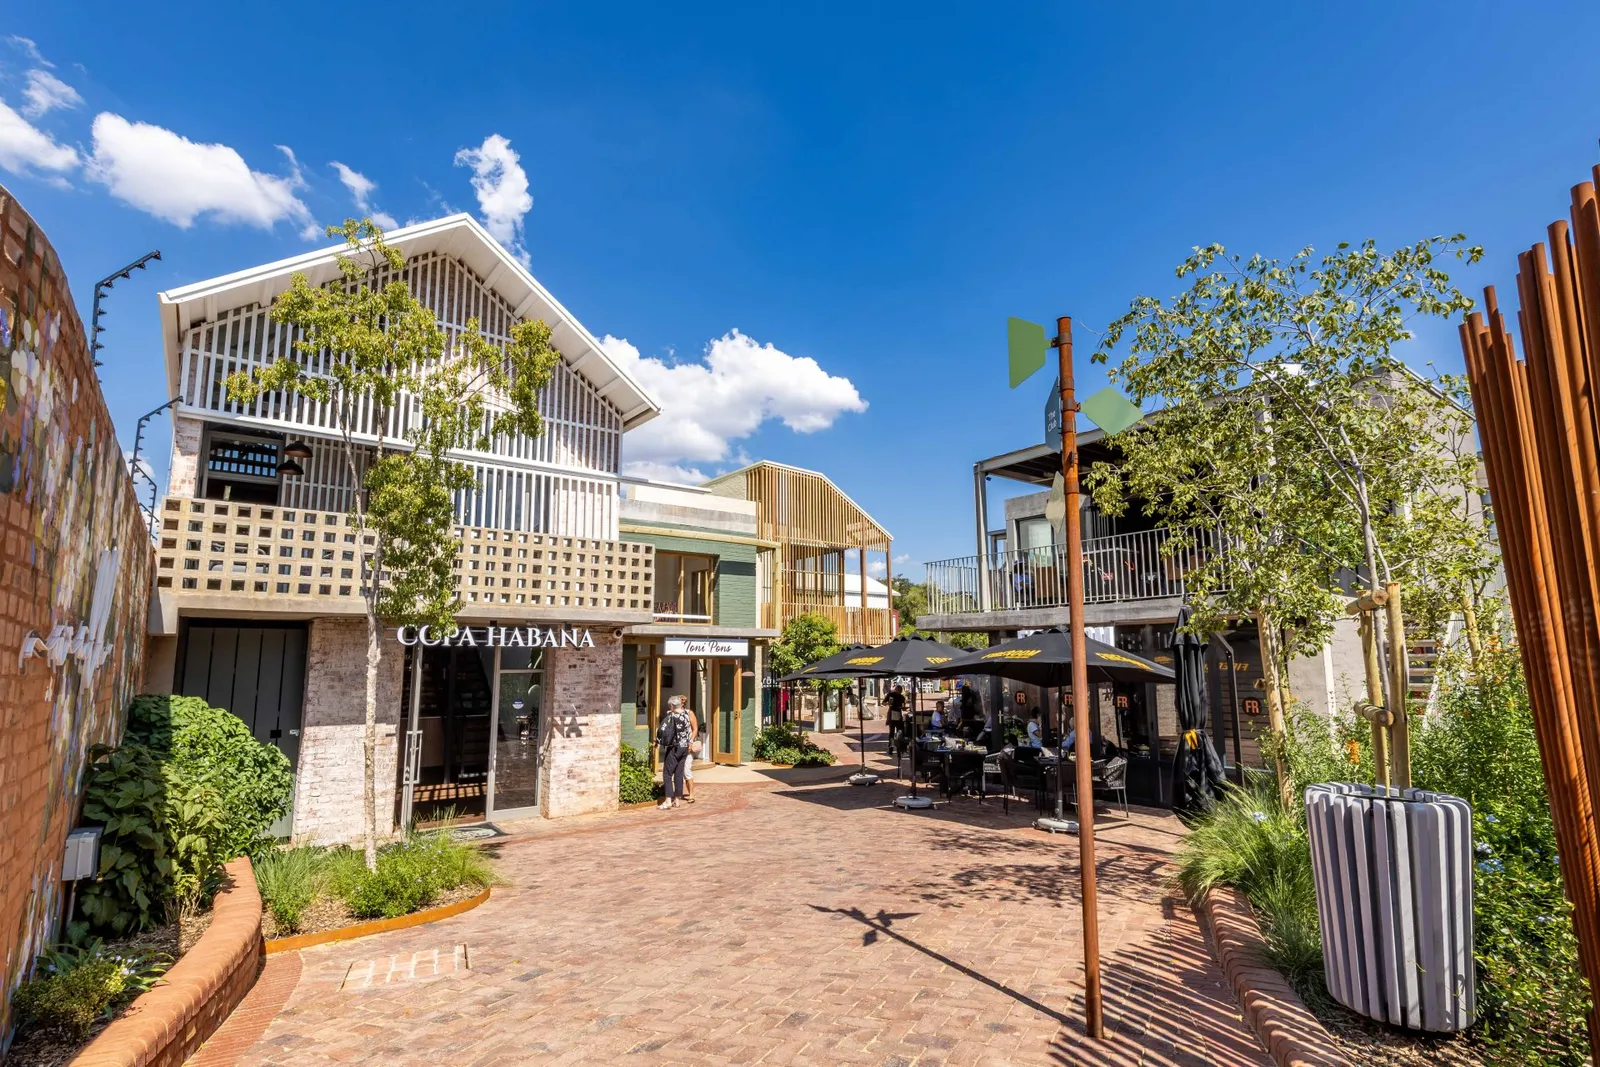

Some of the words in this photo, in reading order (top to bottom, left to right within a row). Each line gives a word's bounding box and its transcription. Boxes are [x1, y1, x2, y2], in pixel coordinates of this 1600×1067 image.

[484, 626, 596, 648] HABANA
[683, 640, 706, 653] Toni
[708, 640, 732, 653] Pons
[1016, 692, 1026, 703] FR
[1116, 696, 1128, 708] FR
[1245, 701, 1259, 714] FR
